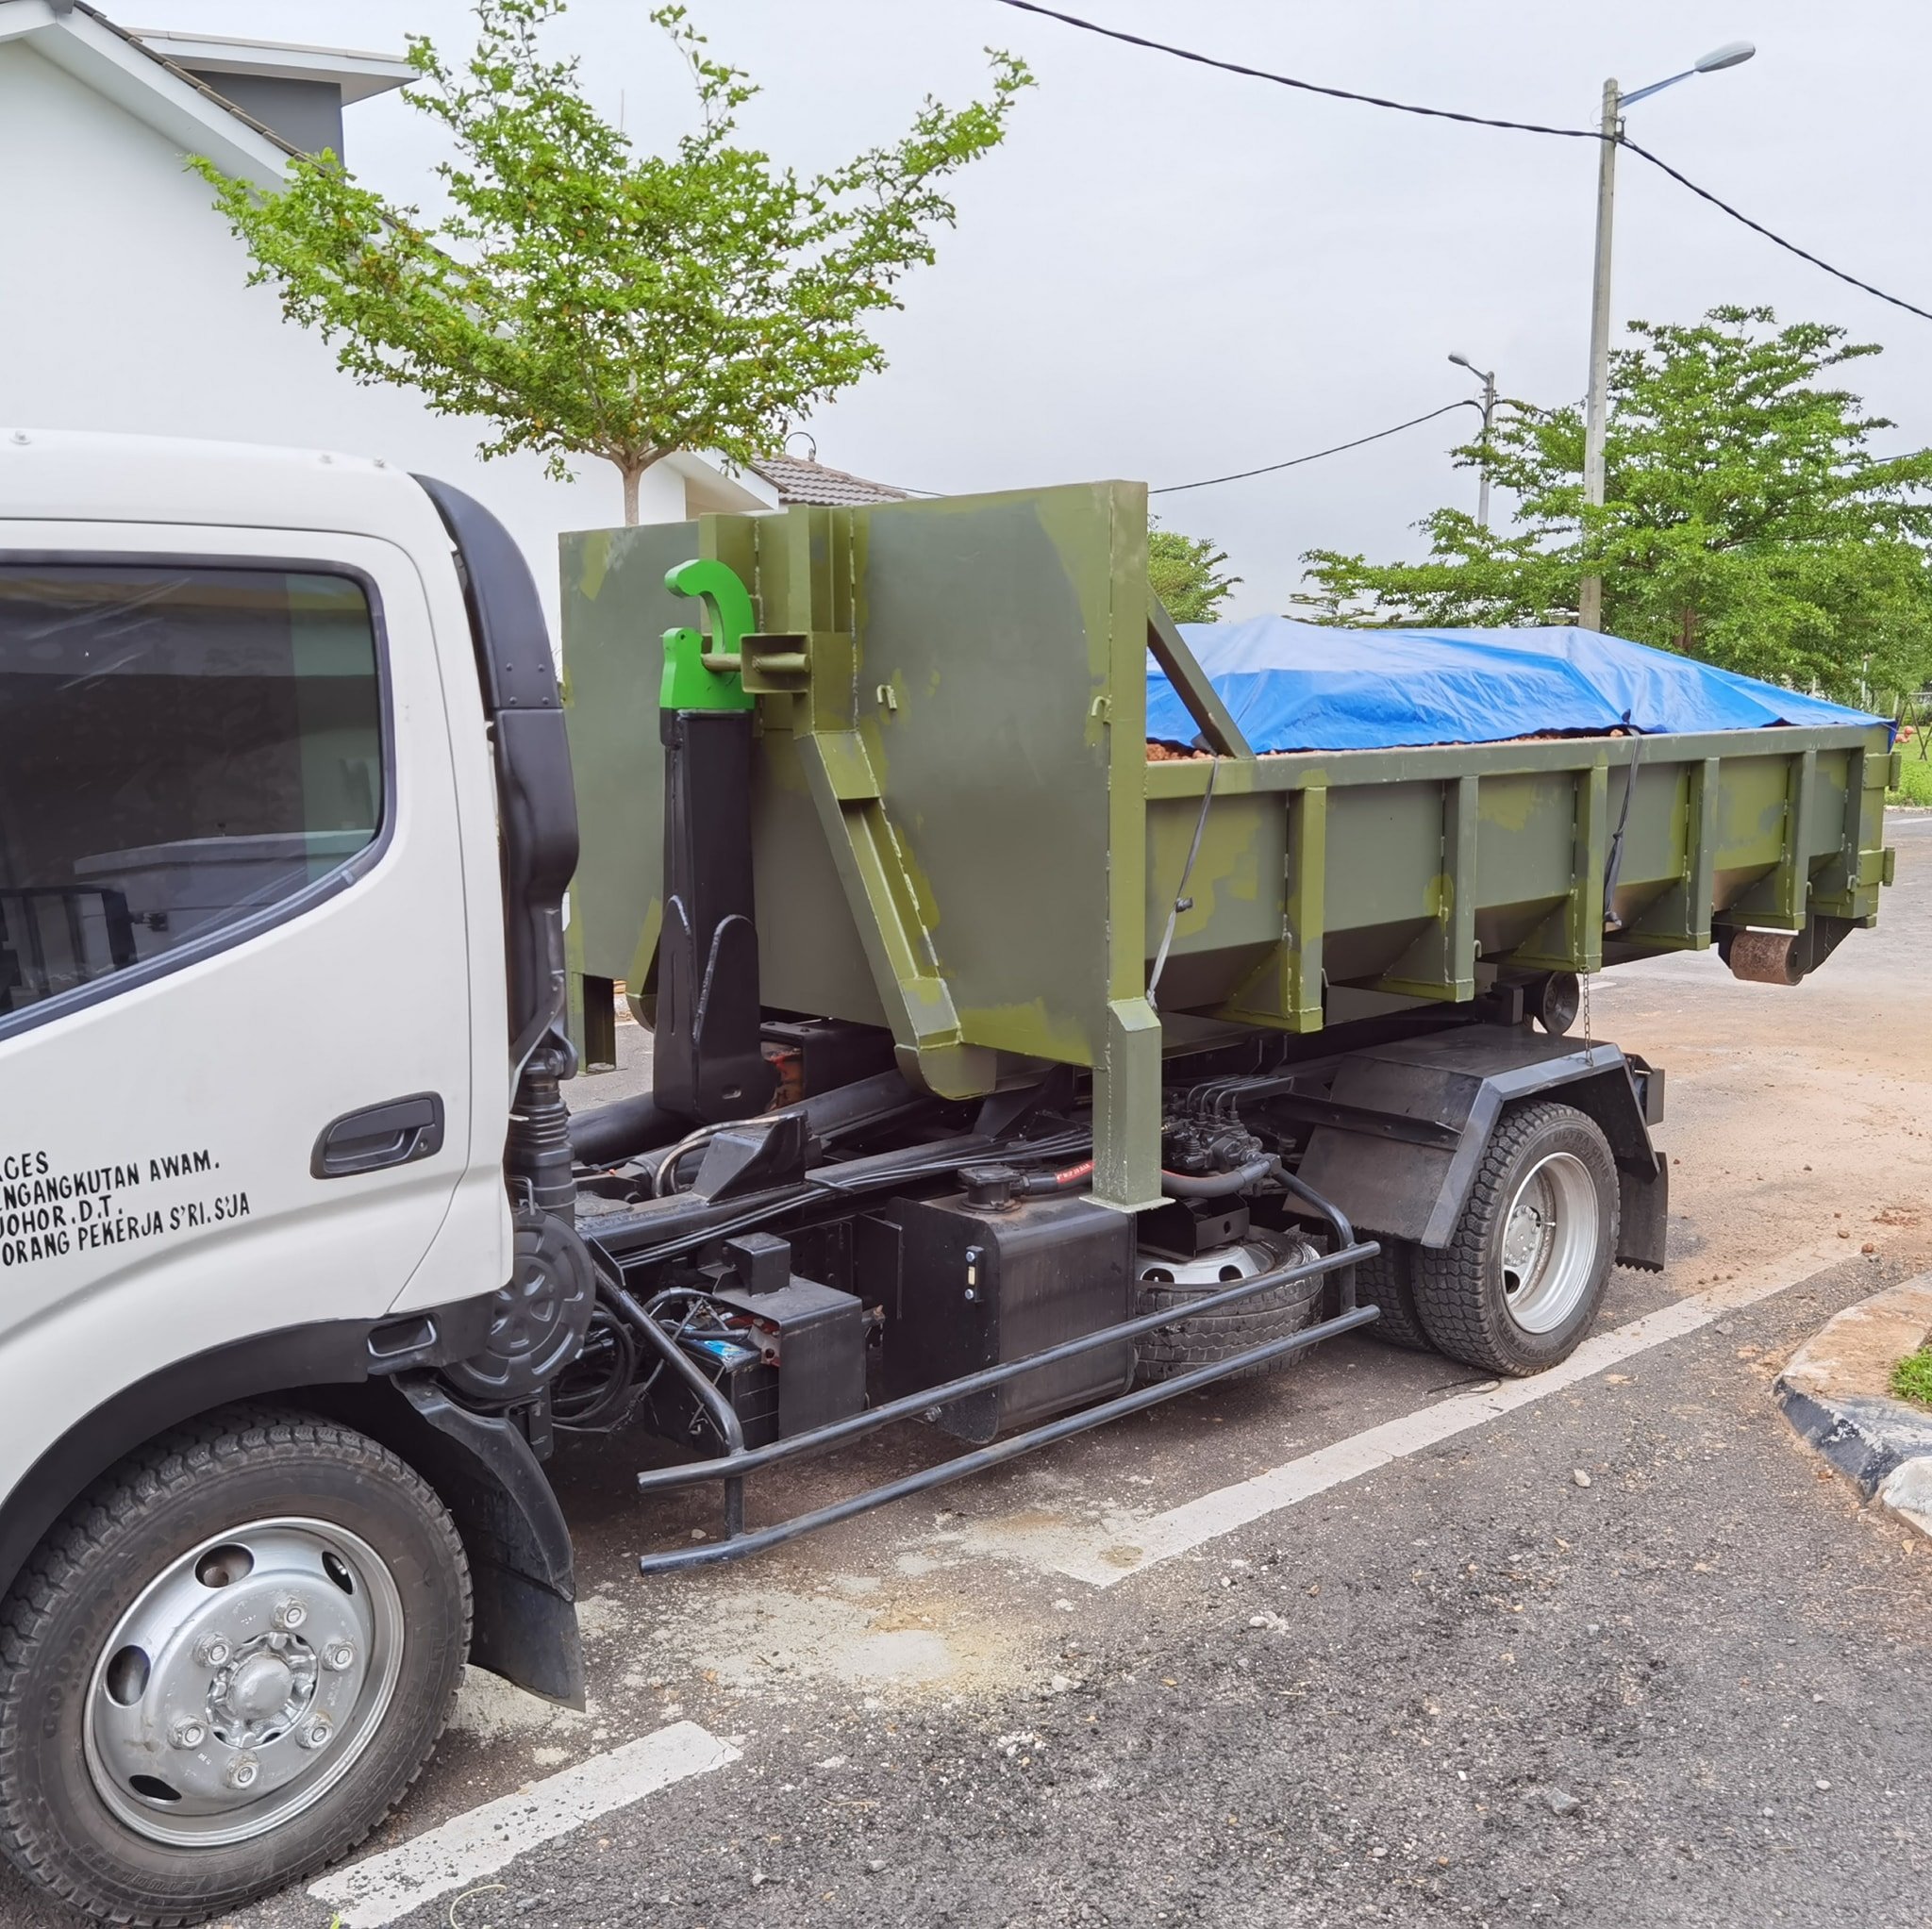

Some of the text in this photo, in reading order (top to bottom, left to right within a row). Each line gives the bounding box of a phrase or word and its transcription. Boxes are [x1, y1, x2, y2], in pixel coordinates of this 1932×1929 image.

[0, 1151, 49, 1182] CES
[0, 1149, 220, 1211] NGANGKUTAN AWAM.
[2, 1230, 71, 1267] ORANG
[77, 1210, 164, 1251] PEKERJA
